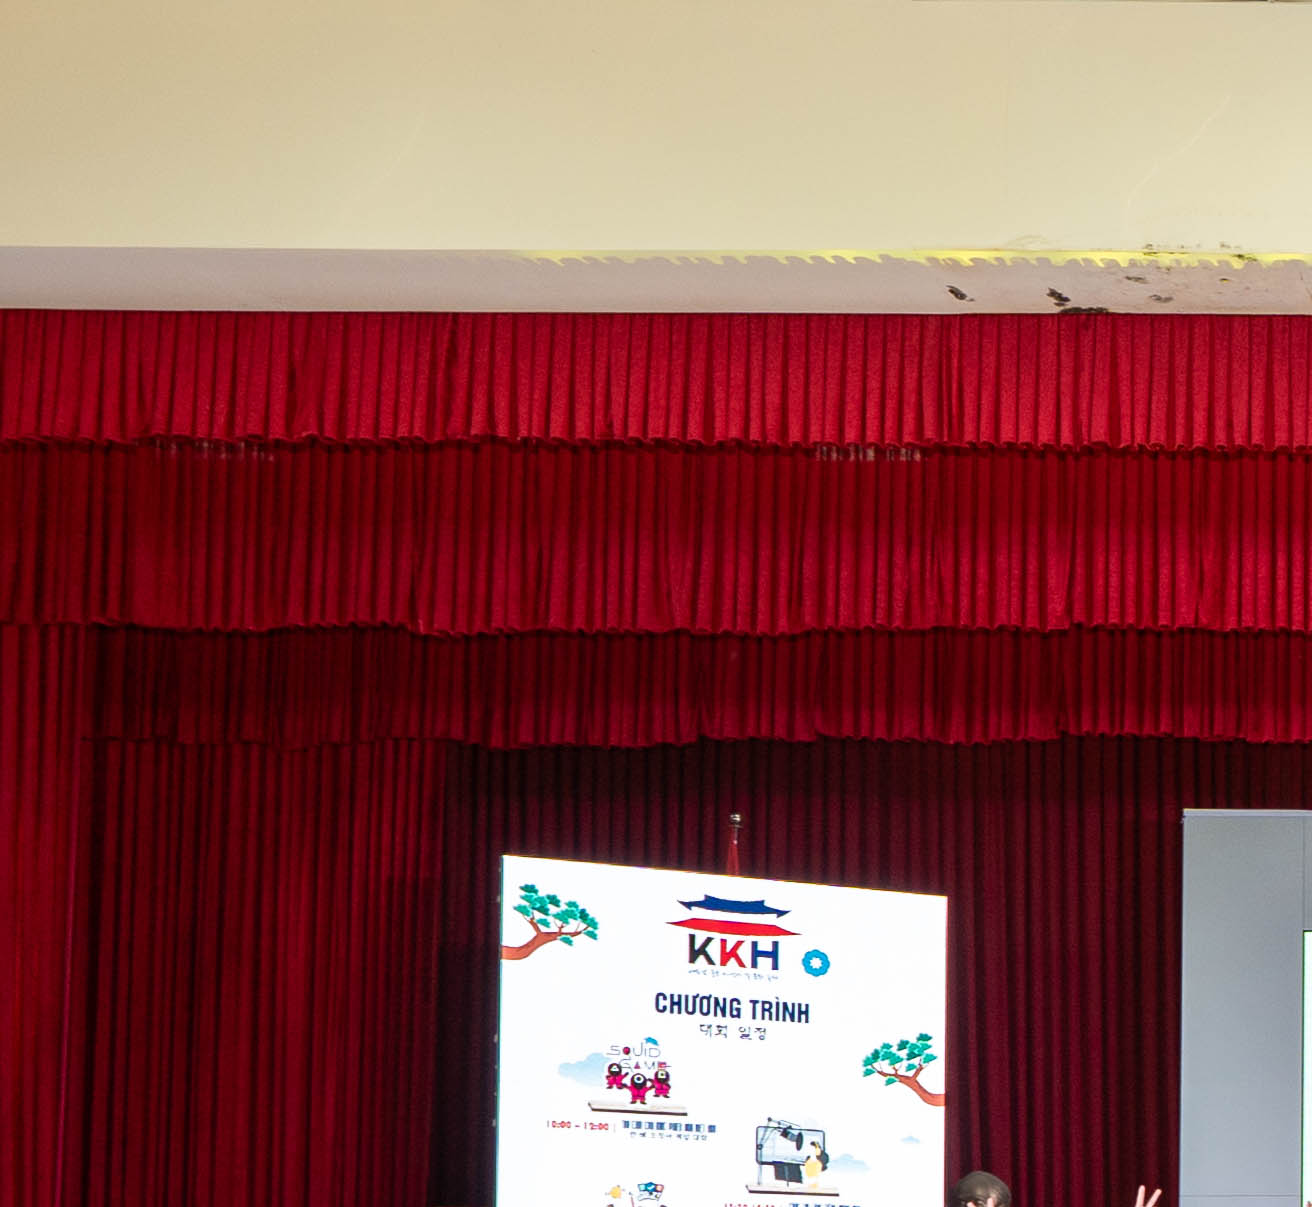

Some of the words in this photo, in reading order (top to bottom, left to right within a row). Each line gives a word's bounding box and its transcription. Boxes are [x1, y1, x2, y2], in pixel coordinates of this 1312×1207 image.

[688, 933, 779, 971] KKH
[655, 991, 742, 1019] CHƯƠNG
[749, 996, 810, 1024] TRÌNH
[699, 1023, 728, 1039] 대회
[738, 1026, 767, 1041] 일정
